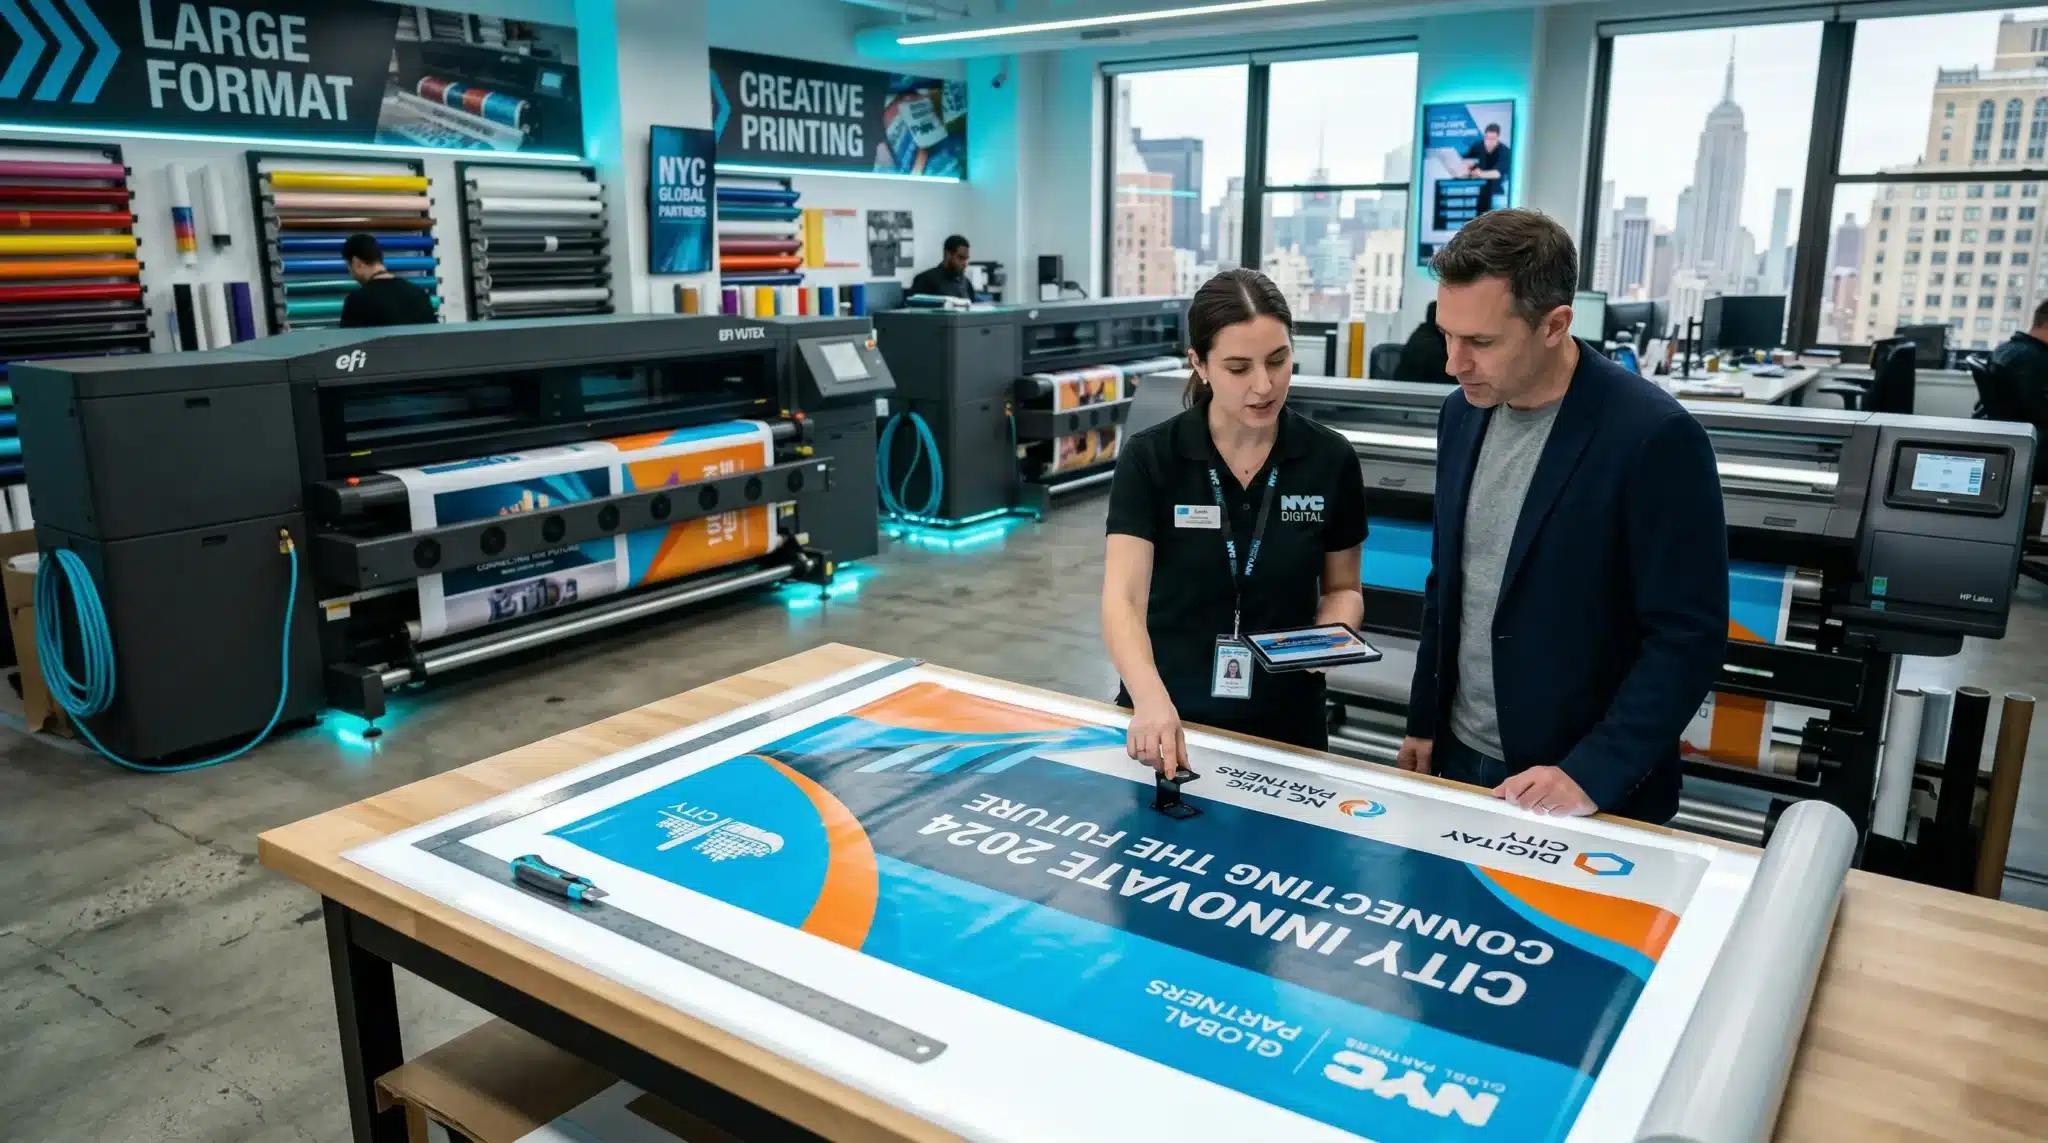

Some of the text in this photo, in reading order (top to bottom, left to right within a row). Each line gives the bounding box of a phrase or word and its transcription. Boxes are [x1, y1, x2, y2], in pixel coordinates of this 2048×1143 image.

[139, 0, 310, 63] LARGE
[146, 59, 353, 121] FORMAT
[740, 70, 864, 118] CREATIVE
[742, 113, 864, 157] PRINTING
[658, 156, 706, 186] NYC
[658, 186, 706, 202] GLOBAL
[658, 205, 706, 218] PARTNERS
[335, 349, 367, 372] efi
[1280, 495, 1325, 511] NYC
[1281, 511, 1325, 522] DIGITAL
[1959, 592, 1972, 601] HP
[1214, 765, 1338, 800] PARTNERS
[667, 801, 719, 822] CITY
[1440, 831, 1562, 865] DIGITAY
[1499, 831, 1570, 852] CITY
[960, 792, 1555, 966] CONNECTING THE FUTURE
[916, 813, 1528, 1007] CITY INNOVATE 2024
[1145, 979, 1303, 1042] PARTNERS
[1164, 1004, 1284, 1058] GLOBAL
[1344, 1037, 1436, 1074] PARTNERS
[1322, 1049, 1500, 1127] NYC
